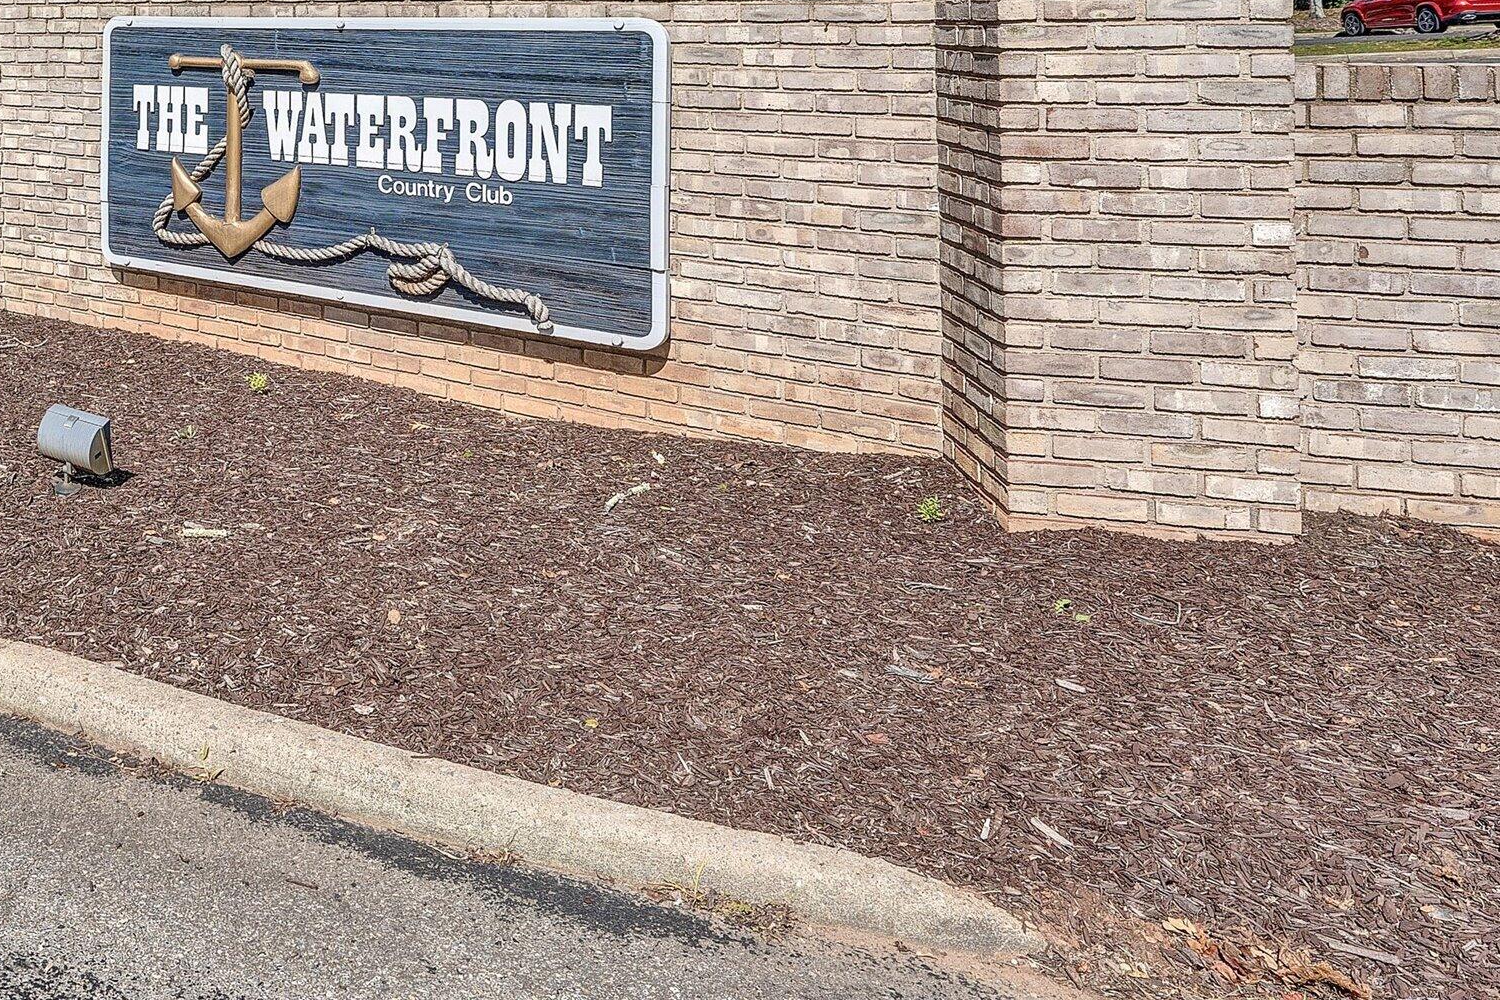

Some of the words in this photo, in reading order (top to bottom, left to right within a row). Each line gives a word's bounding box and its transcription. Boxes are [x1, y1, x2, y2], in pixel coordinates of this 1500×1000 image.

[132, 84, 210, 154] THE
[262, 90, 613, 187] WATERFRONT
[377, 174, 454, 204] Country
[465, 182, 514, 206] Club
